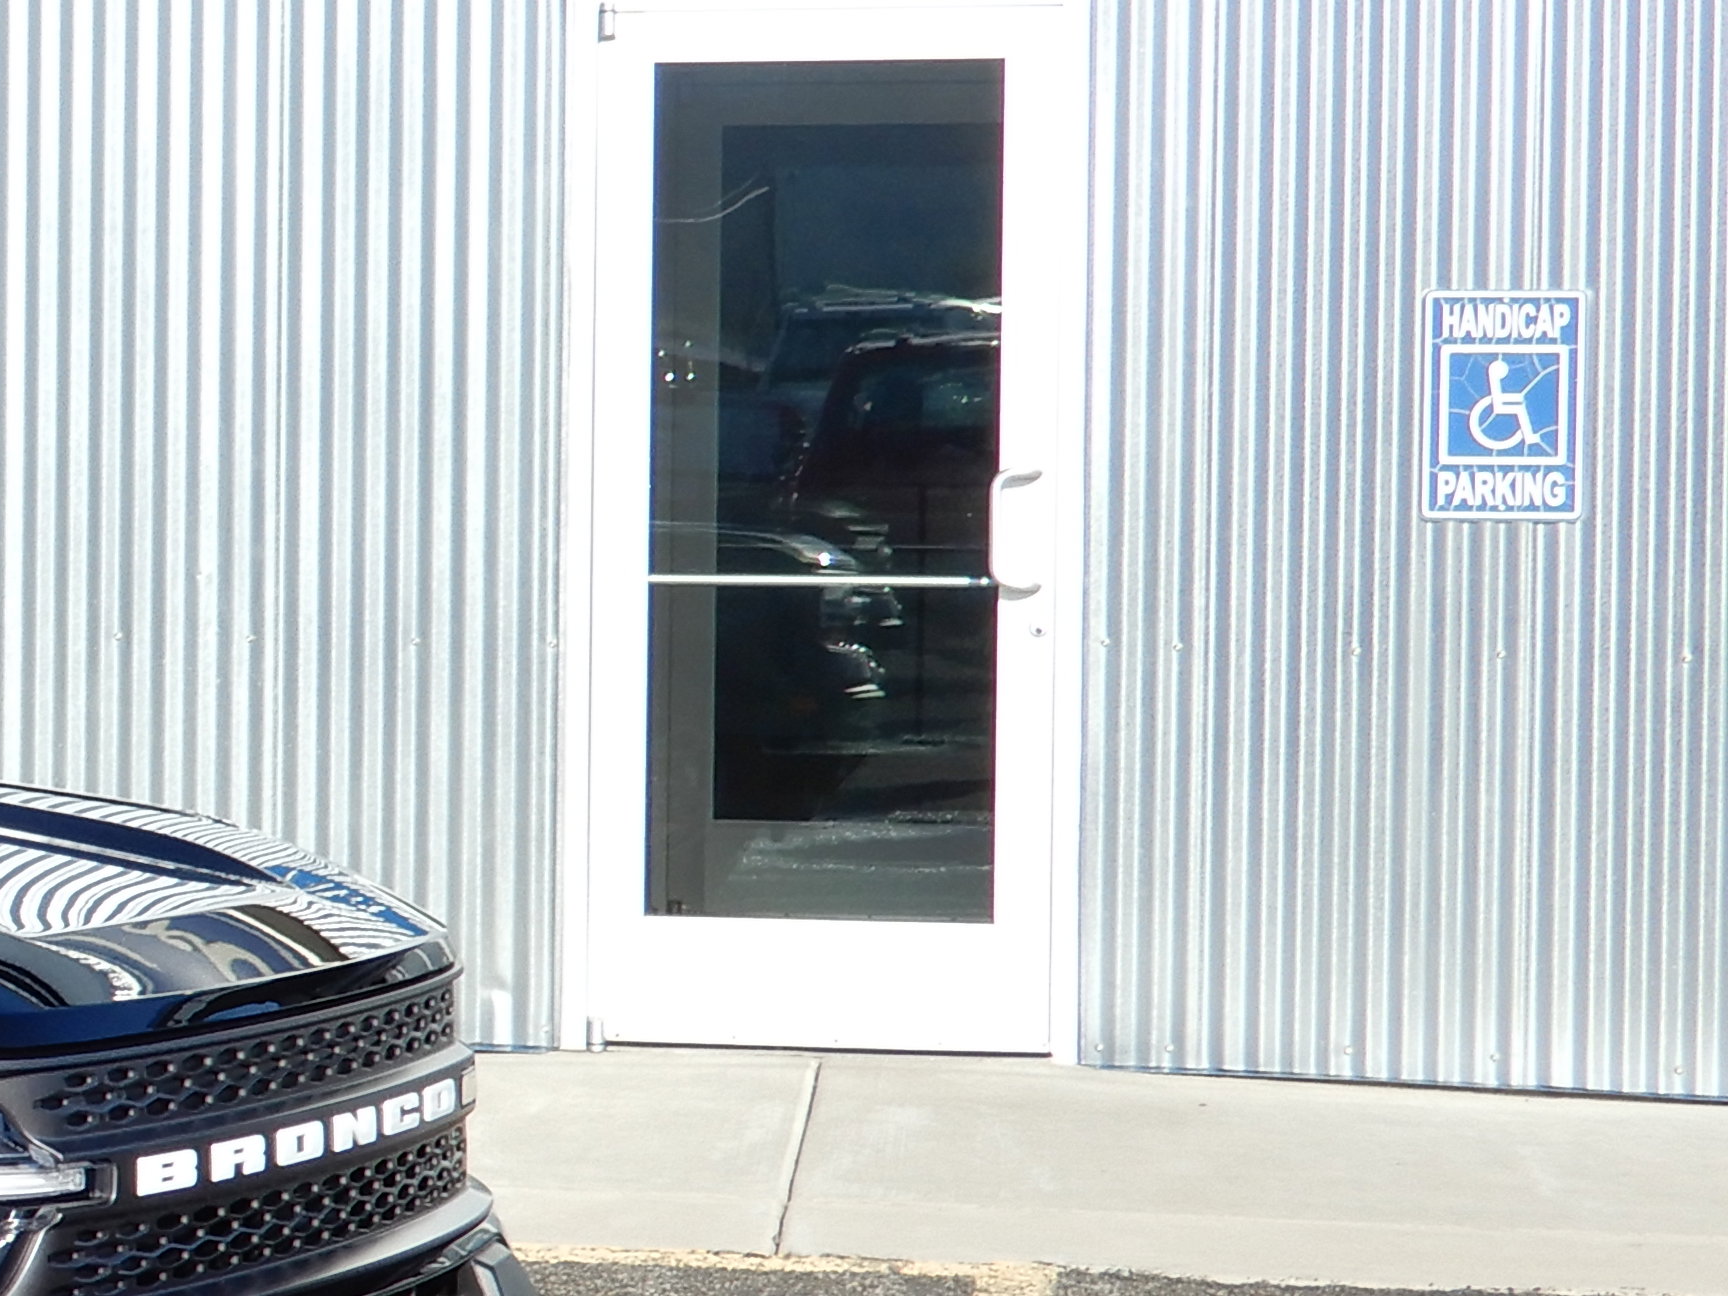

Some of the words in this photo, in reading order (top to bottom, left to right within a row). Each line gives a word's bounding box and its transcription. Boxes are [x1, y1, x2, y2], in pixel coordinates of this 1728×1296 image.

[1442, 303, 1571, 338] HANDICAP
[1436, 470, 1567, 507] PARKING
[135, 1077, 457, 1198] BRONCO
